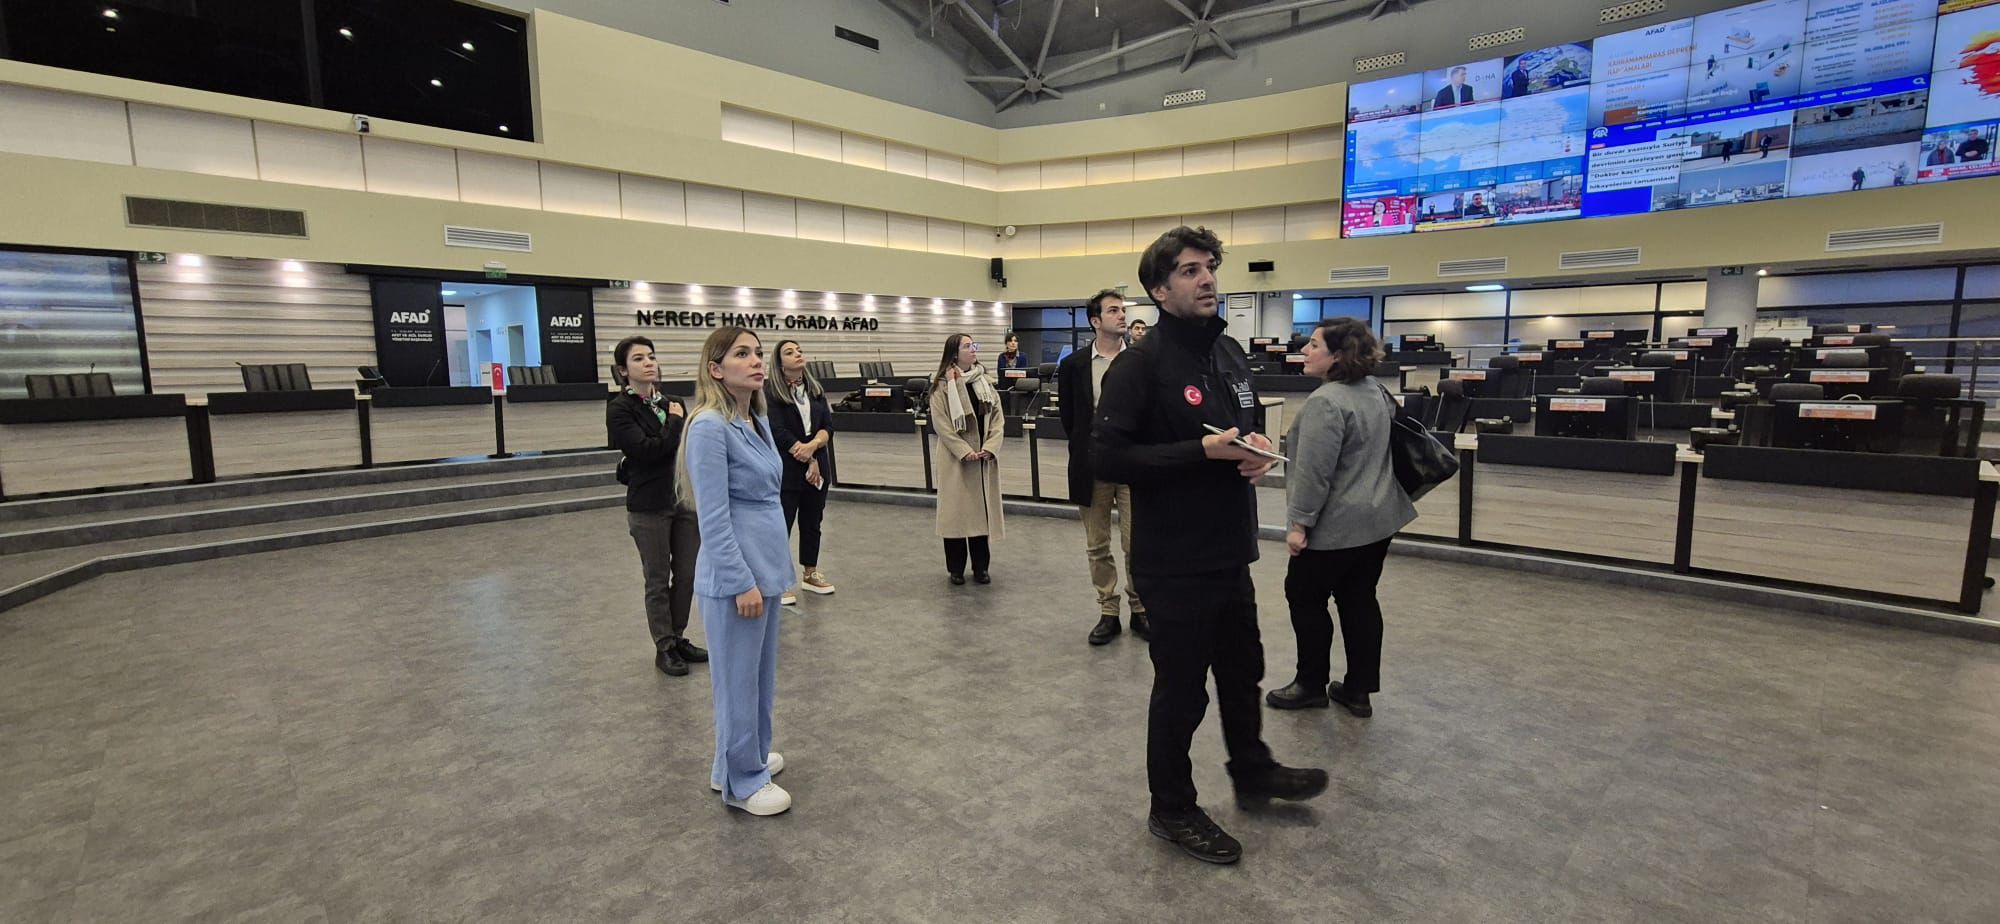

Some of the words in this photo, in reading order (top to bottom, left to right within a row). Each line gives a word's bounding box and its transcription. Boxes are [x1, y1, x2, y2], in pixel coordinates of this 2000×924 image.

[1645, 26, 1666, 36] AFAD
[390, 310, 430, 324] AFAD
[550, 315, 582, 327] AFAD
[637, 310, 716, 327] NEREDE
[721, 312, 779, 330] HAYAT,
[784, 314, 838, 331] ORADA
[842, 317, 879, 331] AFAD
